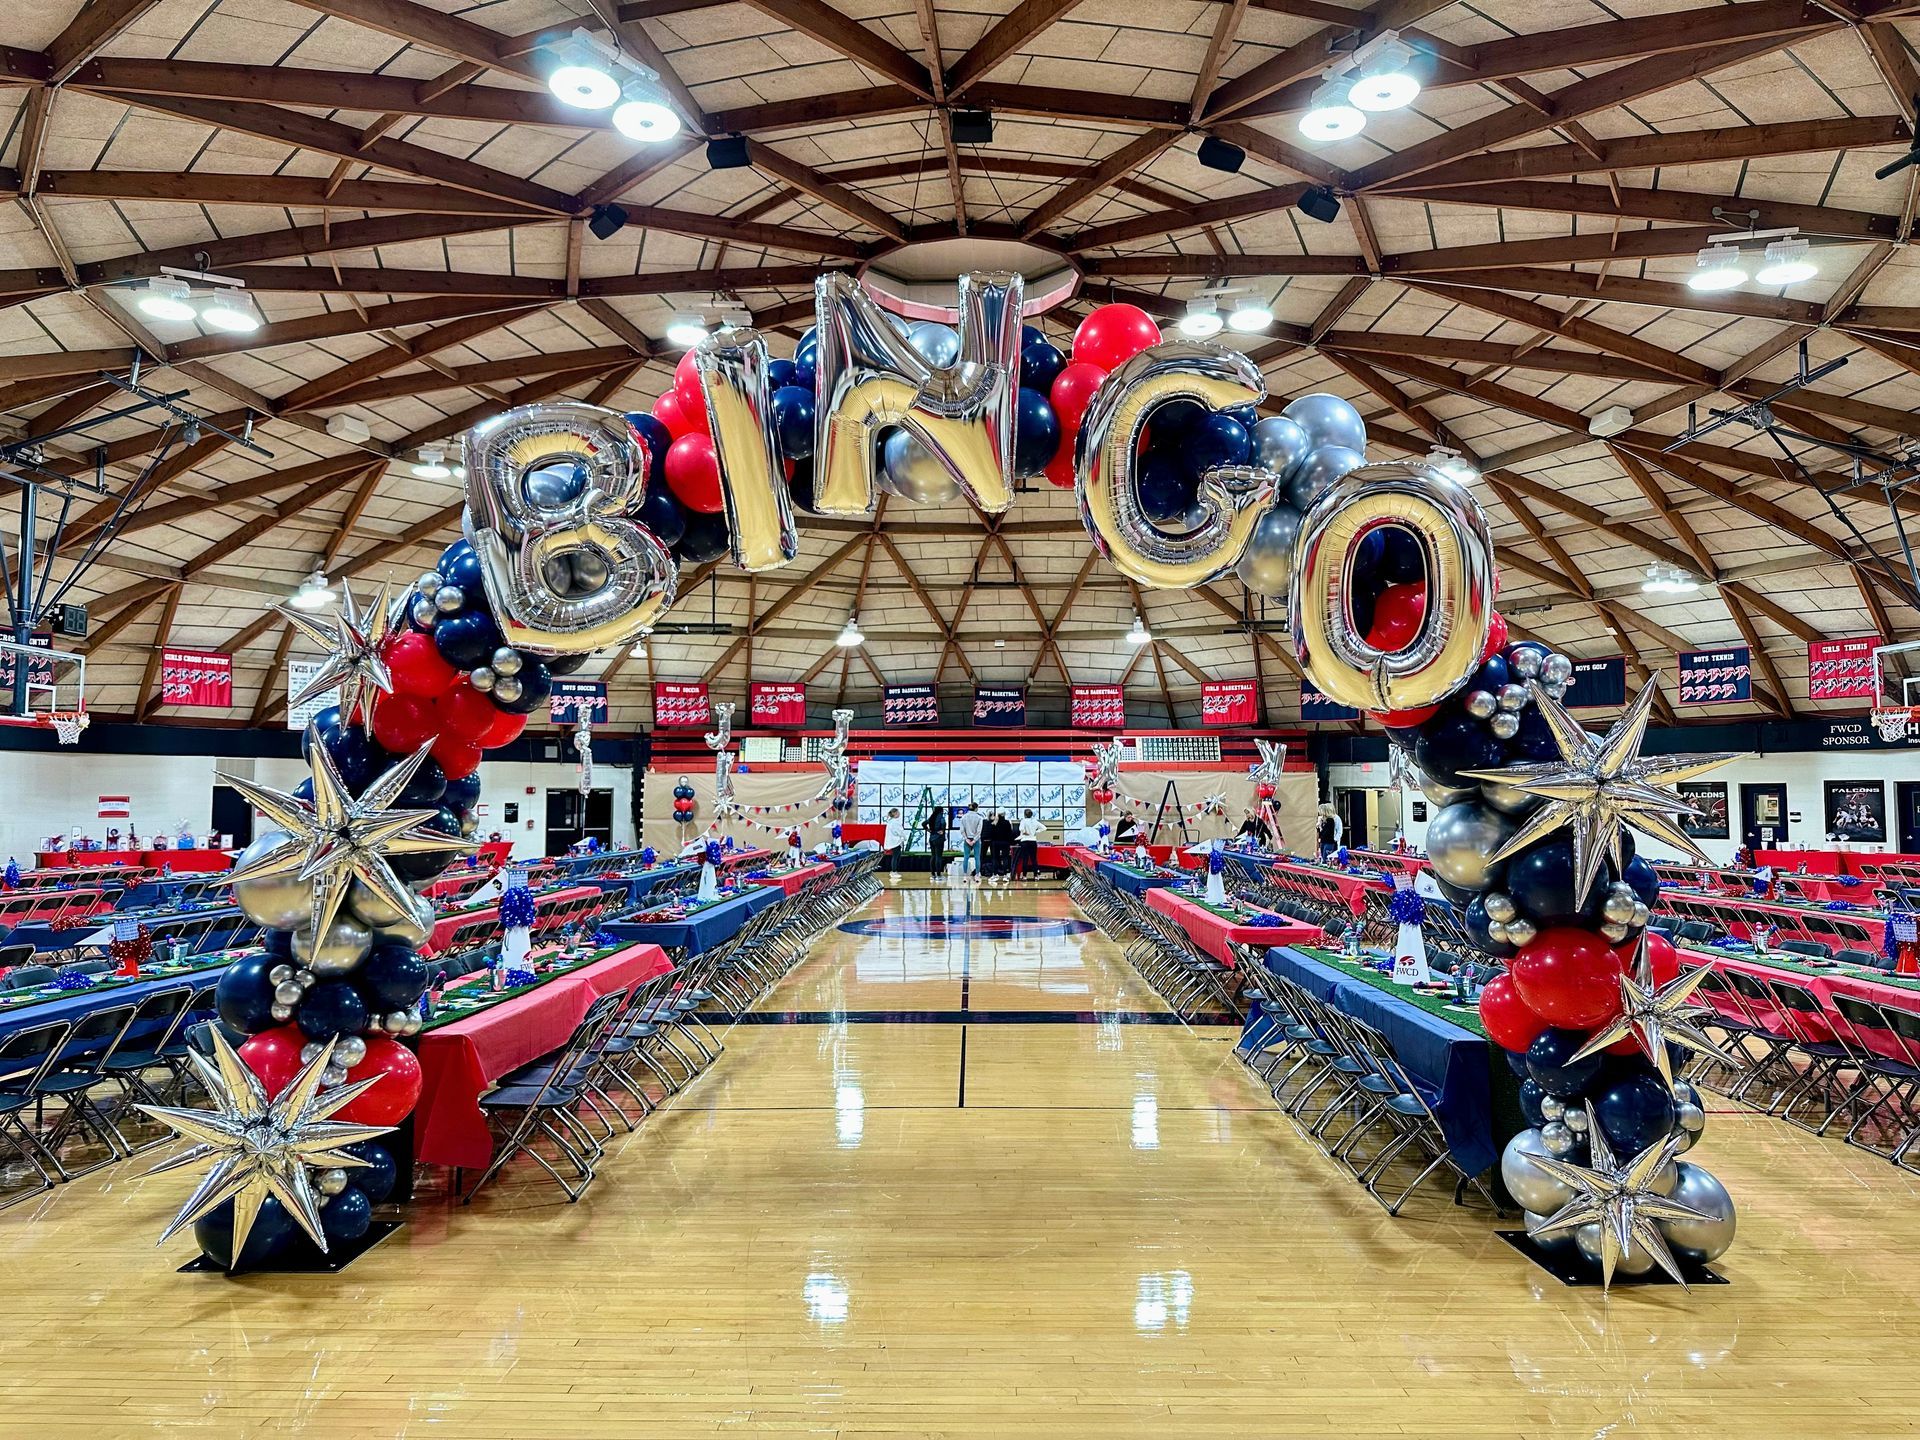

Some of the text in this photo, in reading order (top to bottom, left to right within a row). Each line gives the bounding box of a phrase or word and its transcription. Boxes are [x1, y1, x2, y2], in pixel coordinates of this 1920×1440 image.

[462, 271, 1495, 712] BINGO
[1844, 643, 1868, 652] TENNIS
[1711, 653, 1734, 662] TENNIS
[1575, 663, 1608, 672] BOYS GOLF
[1830, 724, 1862, 734] FWCD
[1822, 735, 1870, 746] SPONSOR
[1683, 791, 1725, 799] FALCONS
[1396, 967, 1419, 977] FWCD
